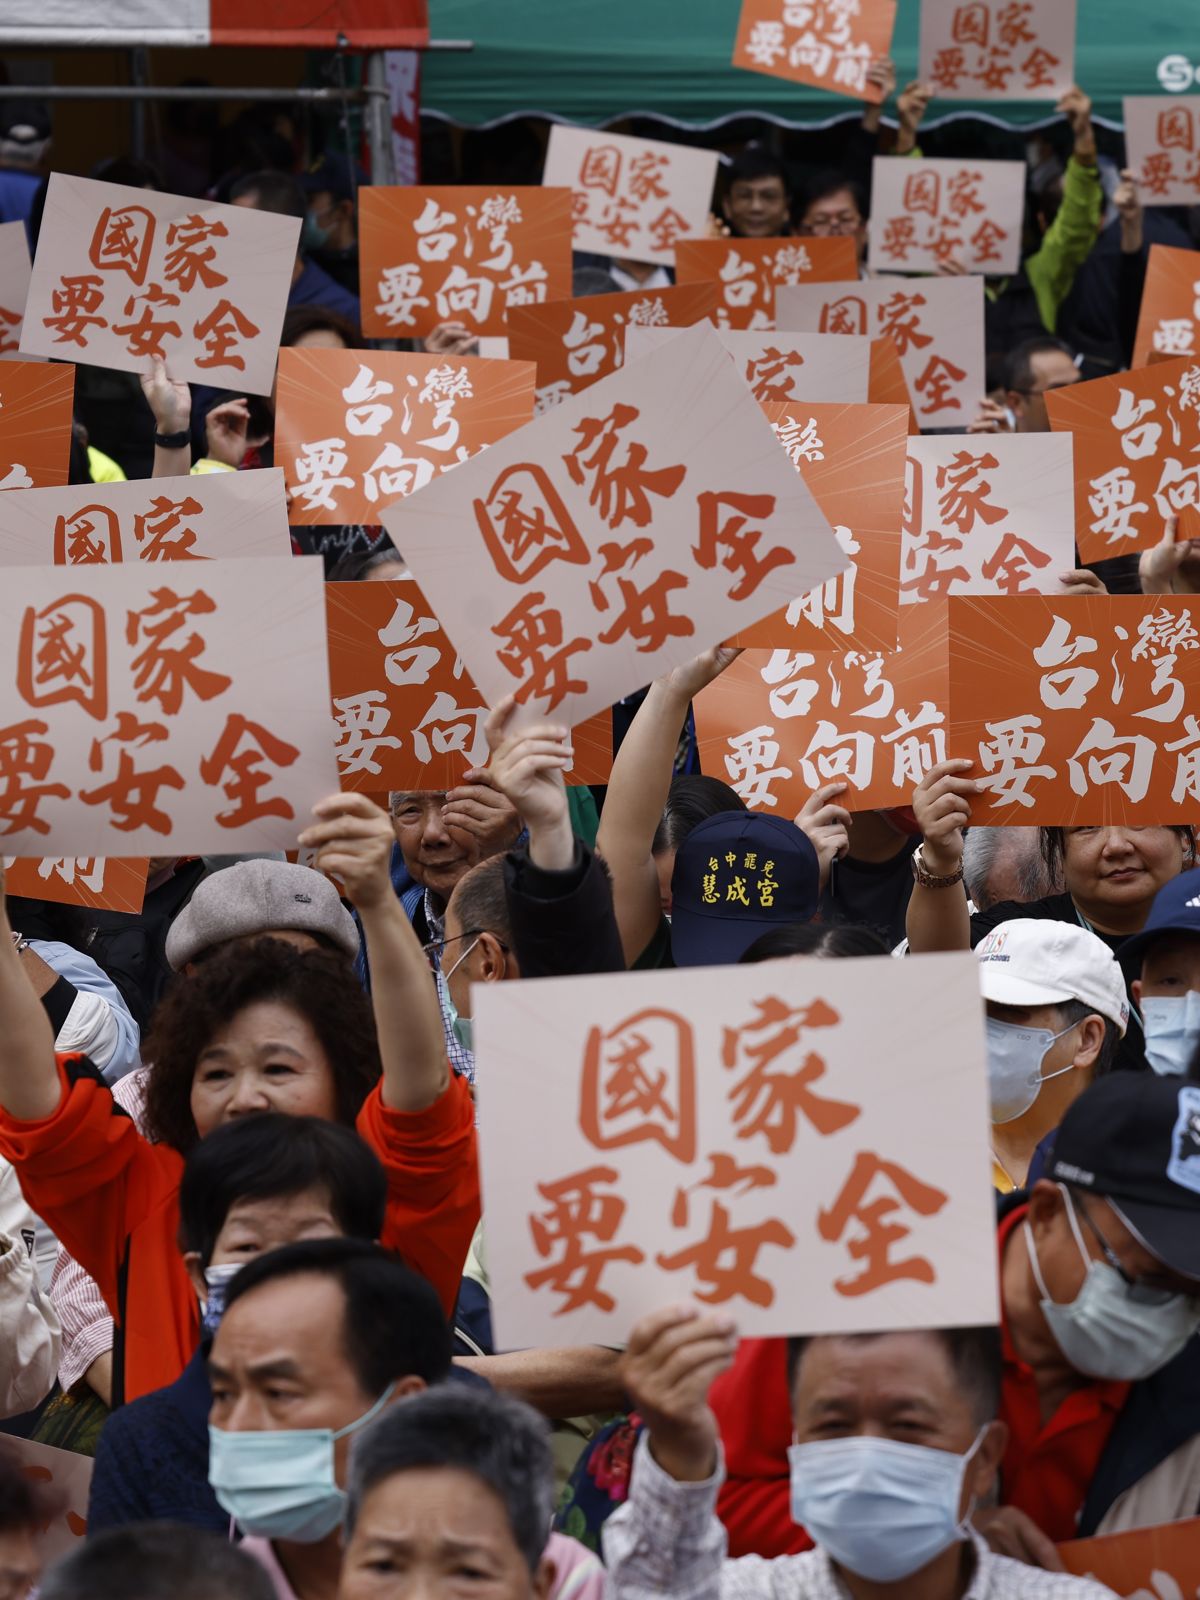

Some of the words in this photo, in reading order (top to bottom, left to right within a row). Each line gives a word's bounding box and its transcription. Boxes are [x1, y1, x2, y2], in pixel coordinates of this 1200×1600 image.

[745, 21, 872, 92] 要向前
[952, 2, 1036, 46] 國家
[930, 45, 1059, 92] 要安全
[579, 145, 672, 198] 國家
[903, 169, 986, 219] 國家
[89, 205, 229, 292] 國家
[413, 194, 523, 271] 台灣
[880, 217, 1008, 262] 要安全
[42, 275, 260, 371] 要安全
[343, 364, 473, 450] 台灣
[474, 403, 687, 584] 國家
[491, 491, 796, 715] 要安全
[16, 586, 232, 722] 國家
[1033, 607, 1200, 722] 台灣
[0, 711, 300, 836] 要安全
[723, 701, 950, 807] 要向前
[702, 874, 779, 907] 慧成宮
[579, 995, 861, 1164] 國家
[523, 1152, 949, 1316] 要安全
